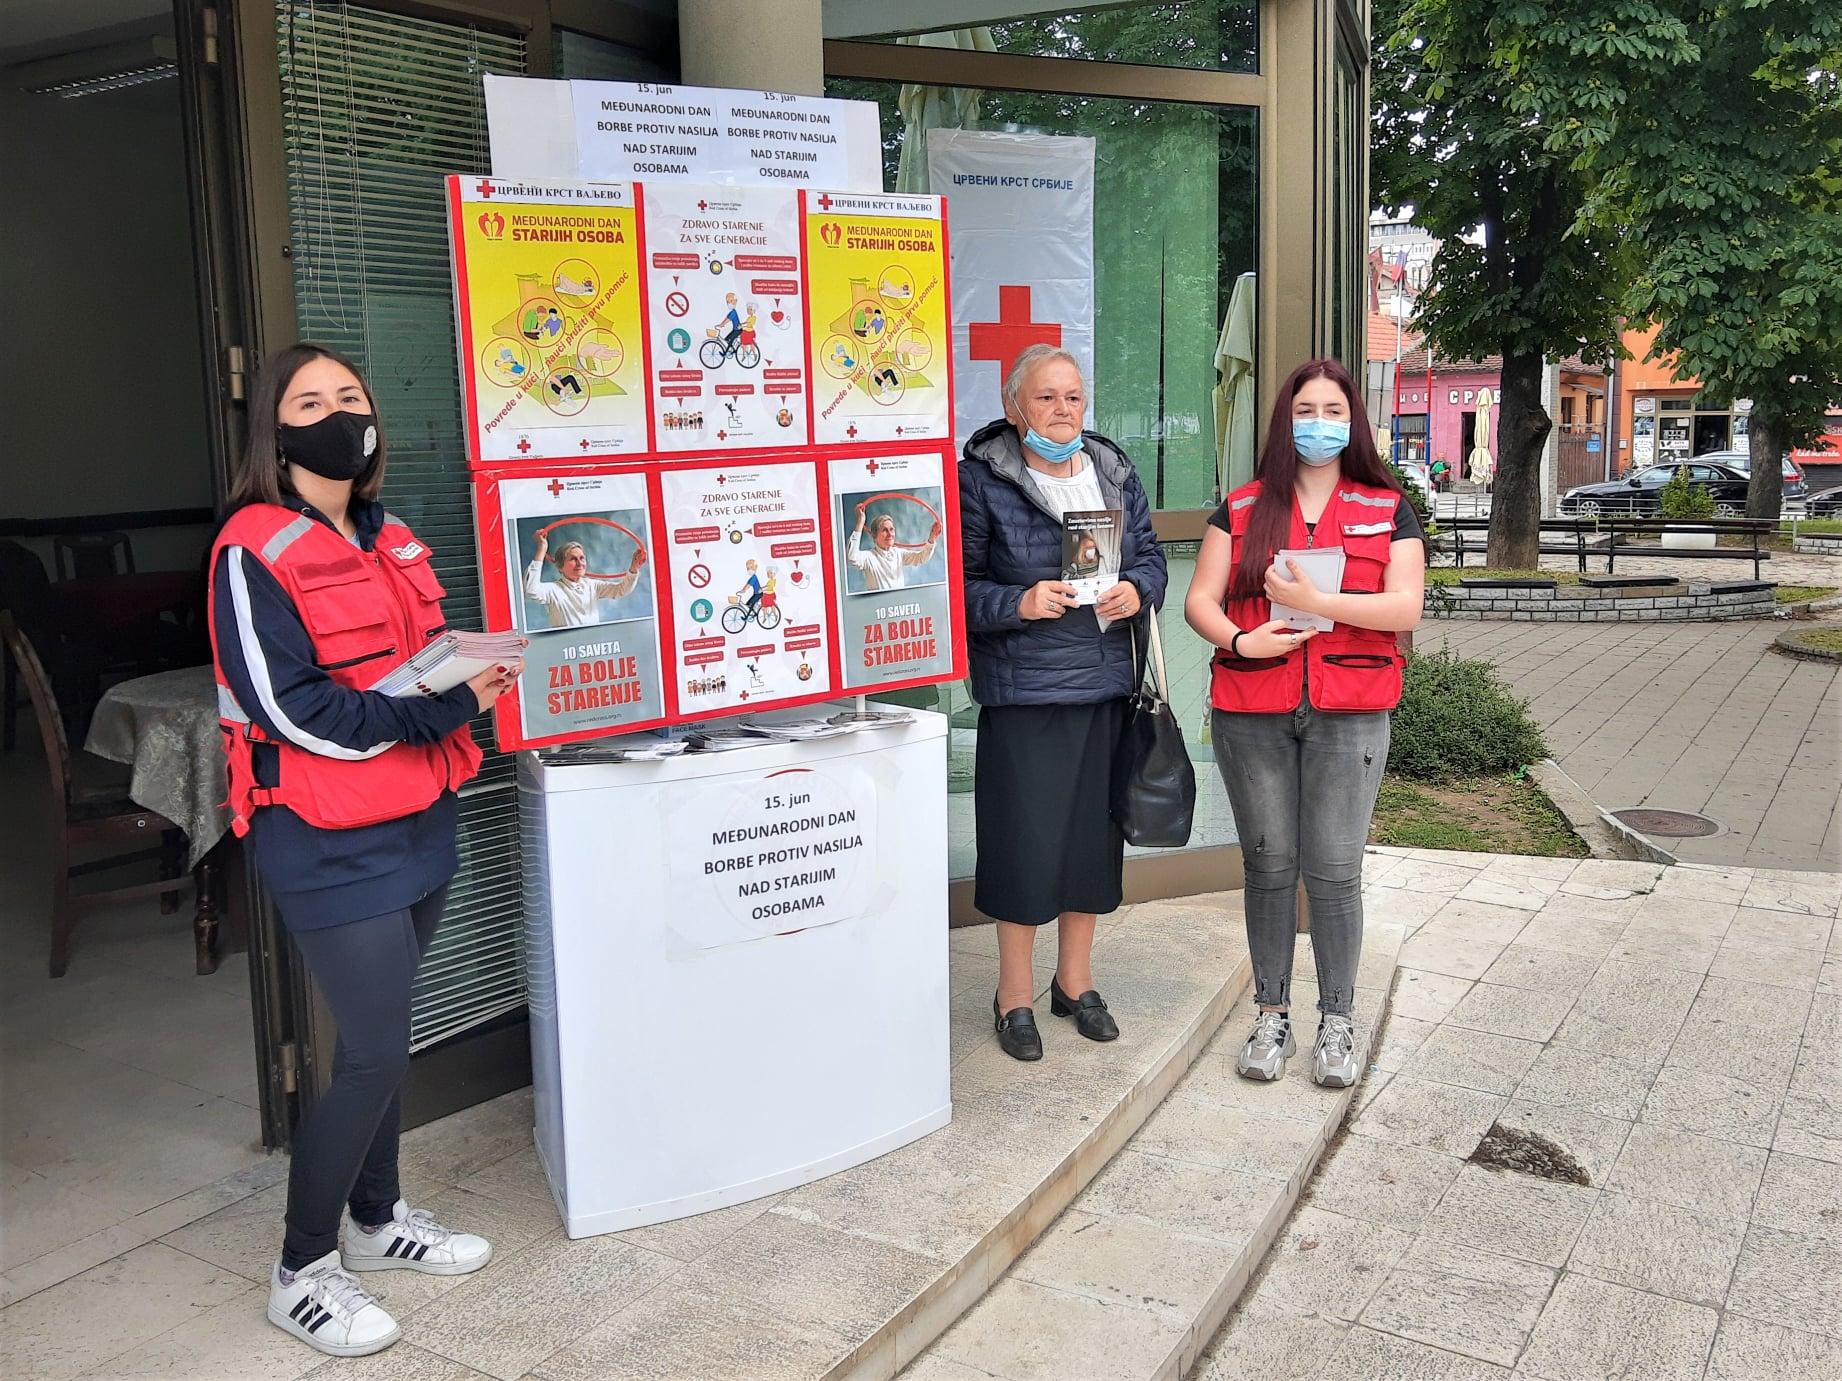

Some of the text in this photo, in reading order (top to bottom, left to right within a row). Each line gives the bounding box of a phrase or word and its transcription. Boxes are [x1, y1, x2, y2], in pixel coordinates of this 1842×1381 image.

[655, 83, 673, 95] jun
[601, 100, 711, 117] MEĐUNARODNI DAN
[731, 107, 831, 124] MEĐUNARODNI DAN
[597, 121, 719, 137] BORBE PROTIV NASILJA
[727, 127, 837, 144] BORBE PROTIV NASILJA
[623, 143, 697, 156] NAD STARIJIM
[750, 148, 817, 162] NAD STARIJIM
[633, 162, 689, 175] OSOBAMA
[759, 167, 810, 180] OSOBAMA
[953, 174, 1073, 190] ЦРВЕНИ КРСТ СРБИЈЕ
[498, 186, 621, 200] ЦРВЕНИ КРСТ ВАЉЕВО
[835, 199, 932, 212] ЦРВЕНИ КРСТ ВАЉЕВО
[599, 218, 621, 229] DAN
[682, 219, 720, 230] ZDRAVO
[512, 228, 625, 244] STARIJIH OSOBA
[680, 233, 692, 243] ZA
[694, 234, 711, 244] SVE
[914, 228, 933, 239] DAN
[847, 237, 936, 253] STARIJIH OSOBA
[484, 399, 517, 434] Povrede
[588, 299, 605, 320] prvu
[604, 270, 630, 301] pomoć
[821, 389, 848, 420] Povrede
[702, 492, 738, 504] ZDRAVO
[700, 508, 712, 517] ZA
[715, 506, 731, 516] SVE
[875, 603, 921, 620] 10 SAVETA
[864, 616, 933, 645] ZA BOLJE
[563, 641, 621, 660] 10 SAVETA
[863, 638, 937, 668] STARENJE
[548, 656, 637, 689] ZA BOLJE
[547, 681, 642, 715] STARENJE
[764, 793, 810, 810] 15. jun
[712, 809, 856, 846] MEĐUNARODNI DAN
[704, 835, 863, 875] BORBE PROTIV NASILJA
[738, 867, 836, 898] NAD STARIJIM
[752, 894, 825, 920] OSOBAMA
